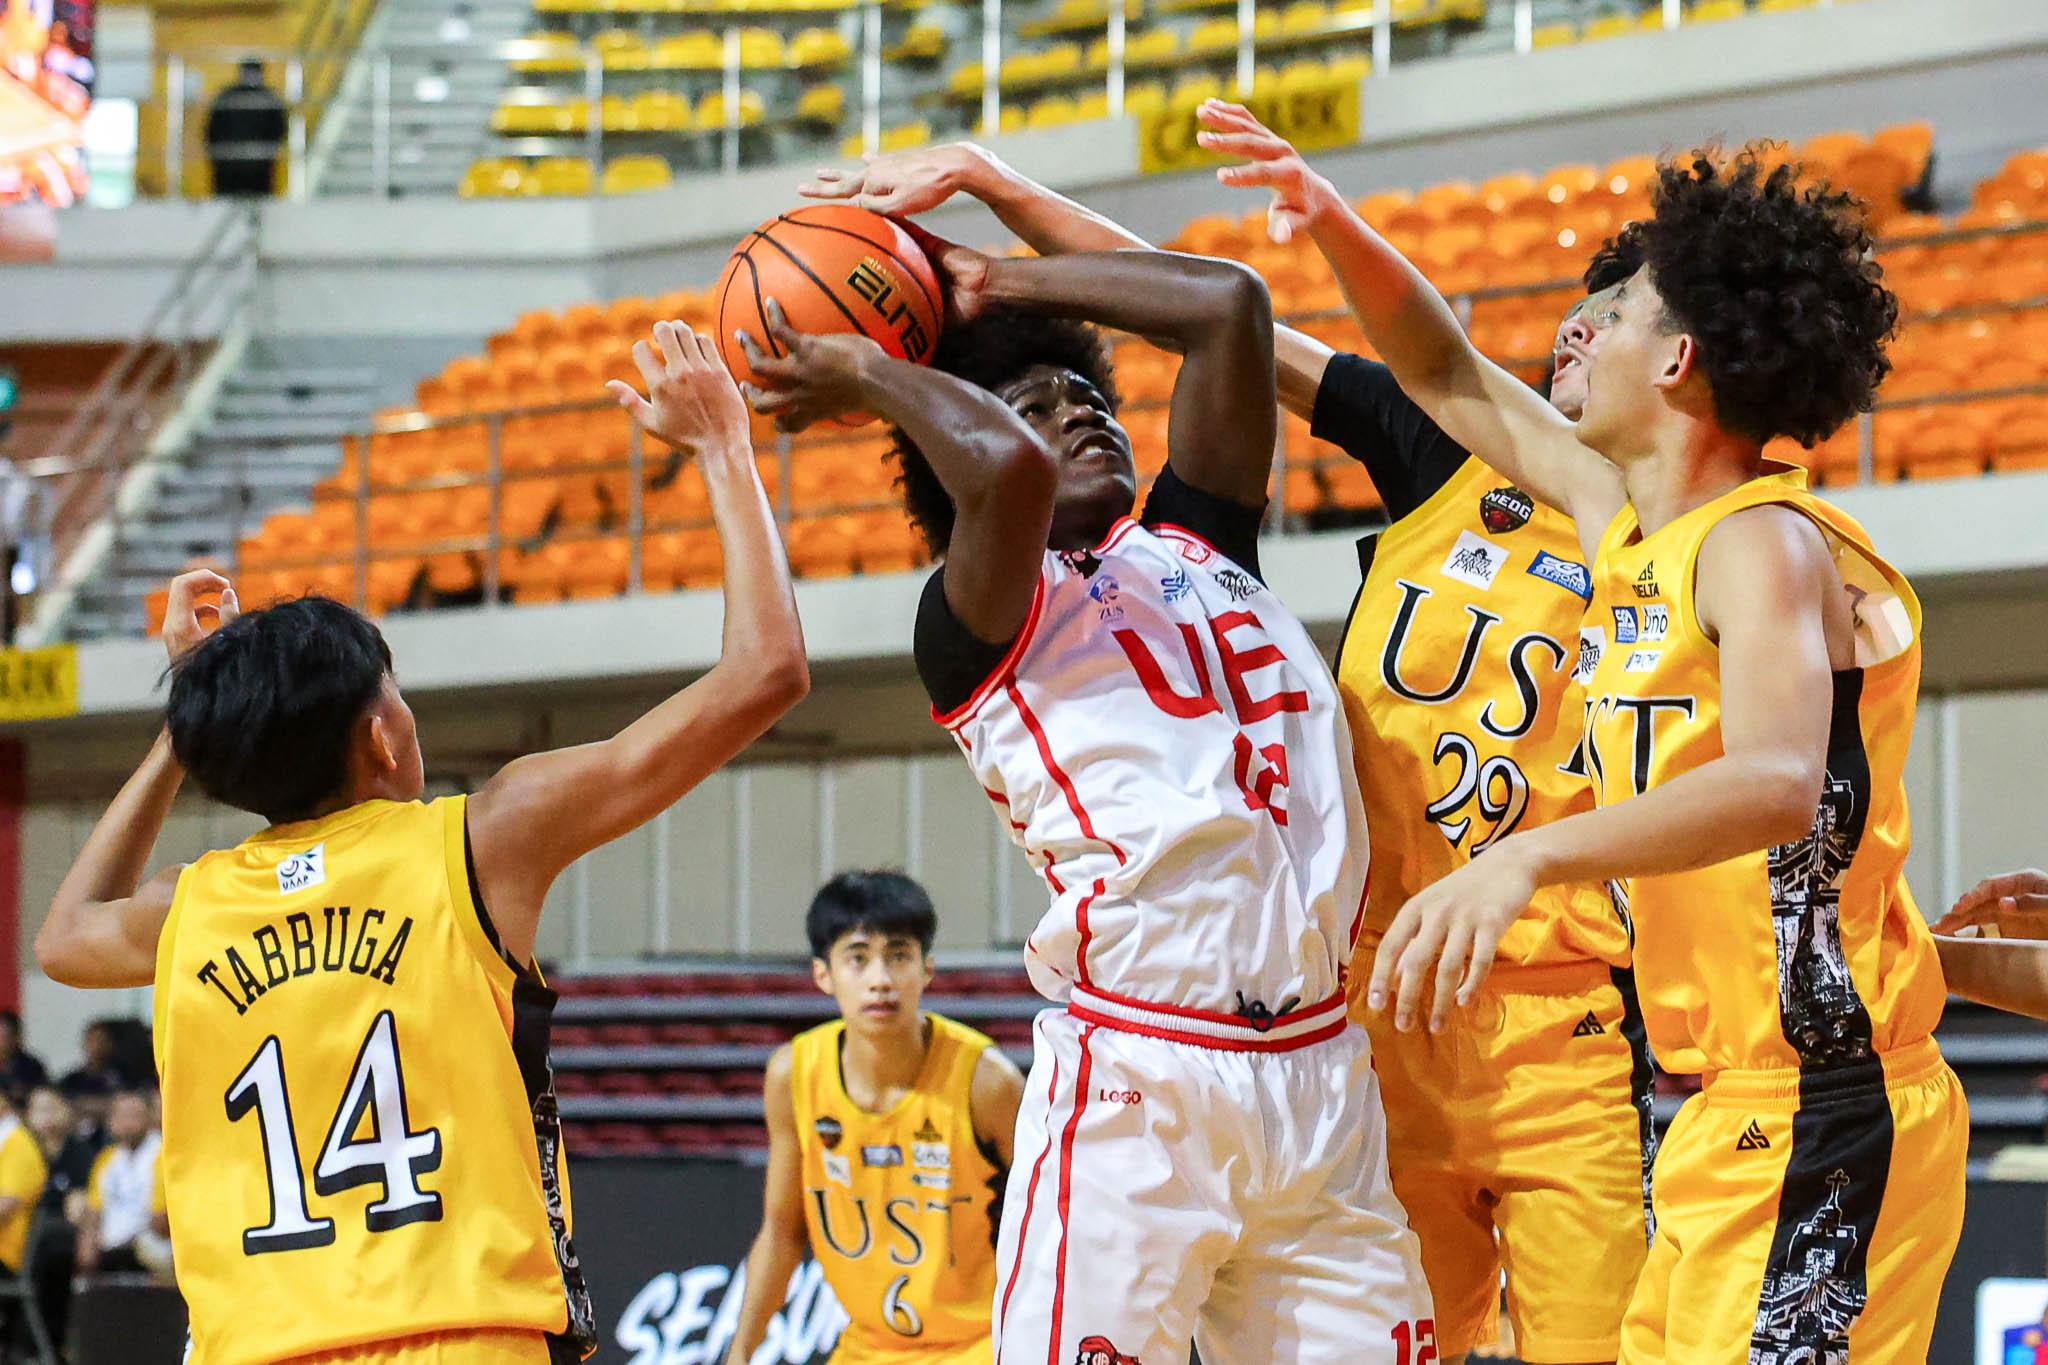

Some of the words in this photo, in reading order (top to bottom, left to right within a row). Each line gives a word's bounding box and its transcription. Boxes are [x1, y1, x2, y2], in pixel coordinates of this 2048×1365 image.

[846, 263, 929, 364] ELITE
[1632, 583, 1660, 598] DELTA
[1111, 610, 1309, 726] UE
[1425, 731, 1530, 858] 29
[282, 875, 309, 891] UAAP
[197, 906, 413, 1016] TABBUGA
[224, 1009, 443, 1256] 14
[1100, 1088, 1142, 1104] LOGO
[807, 1188, 972, 1268] UST
[882, 1274, 923, 1337] 6
[1390, 1318, 1438, 1365] 12
